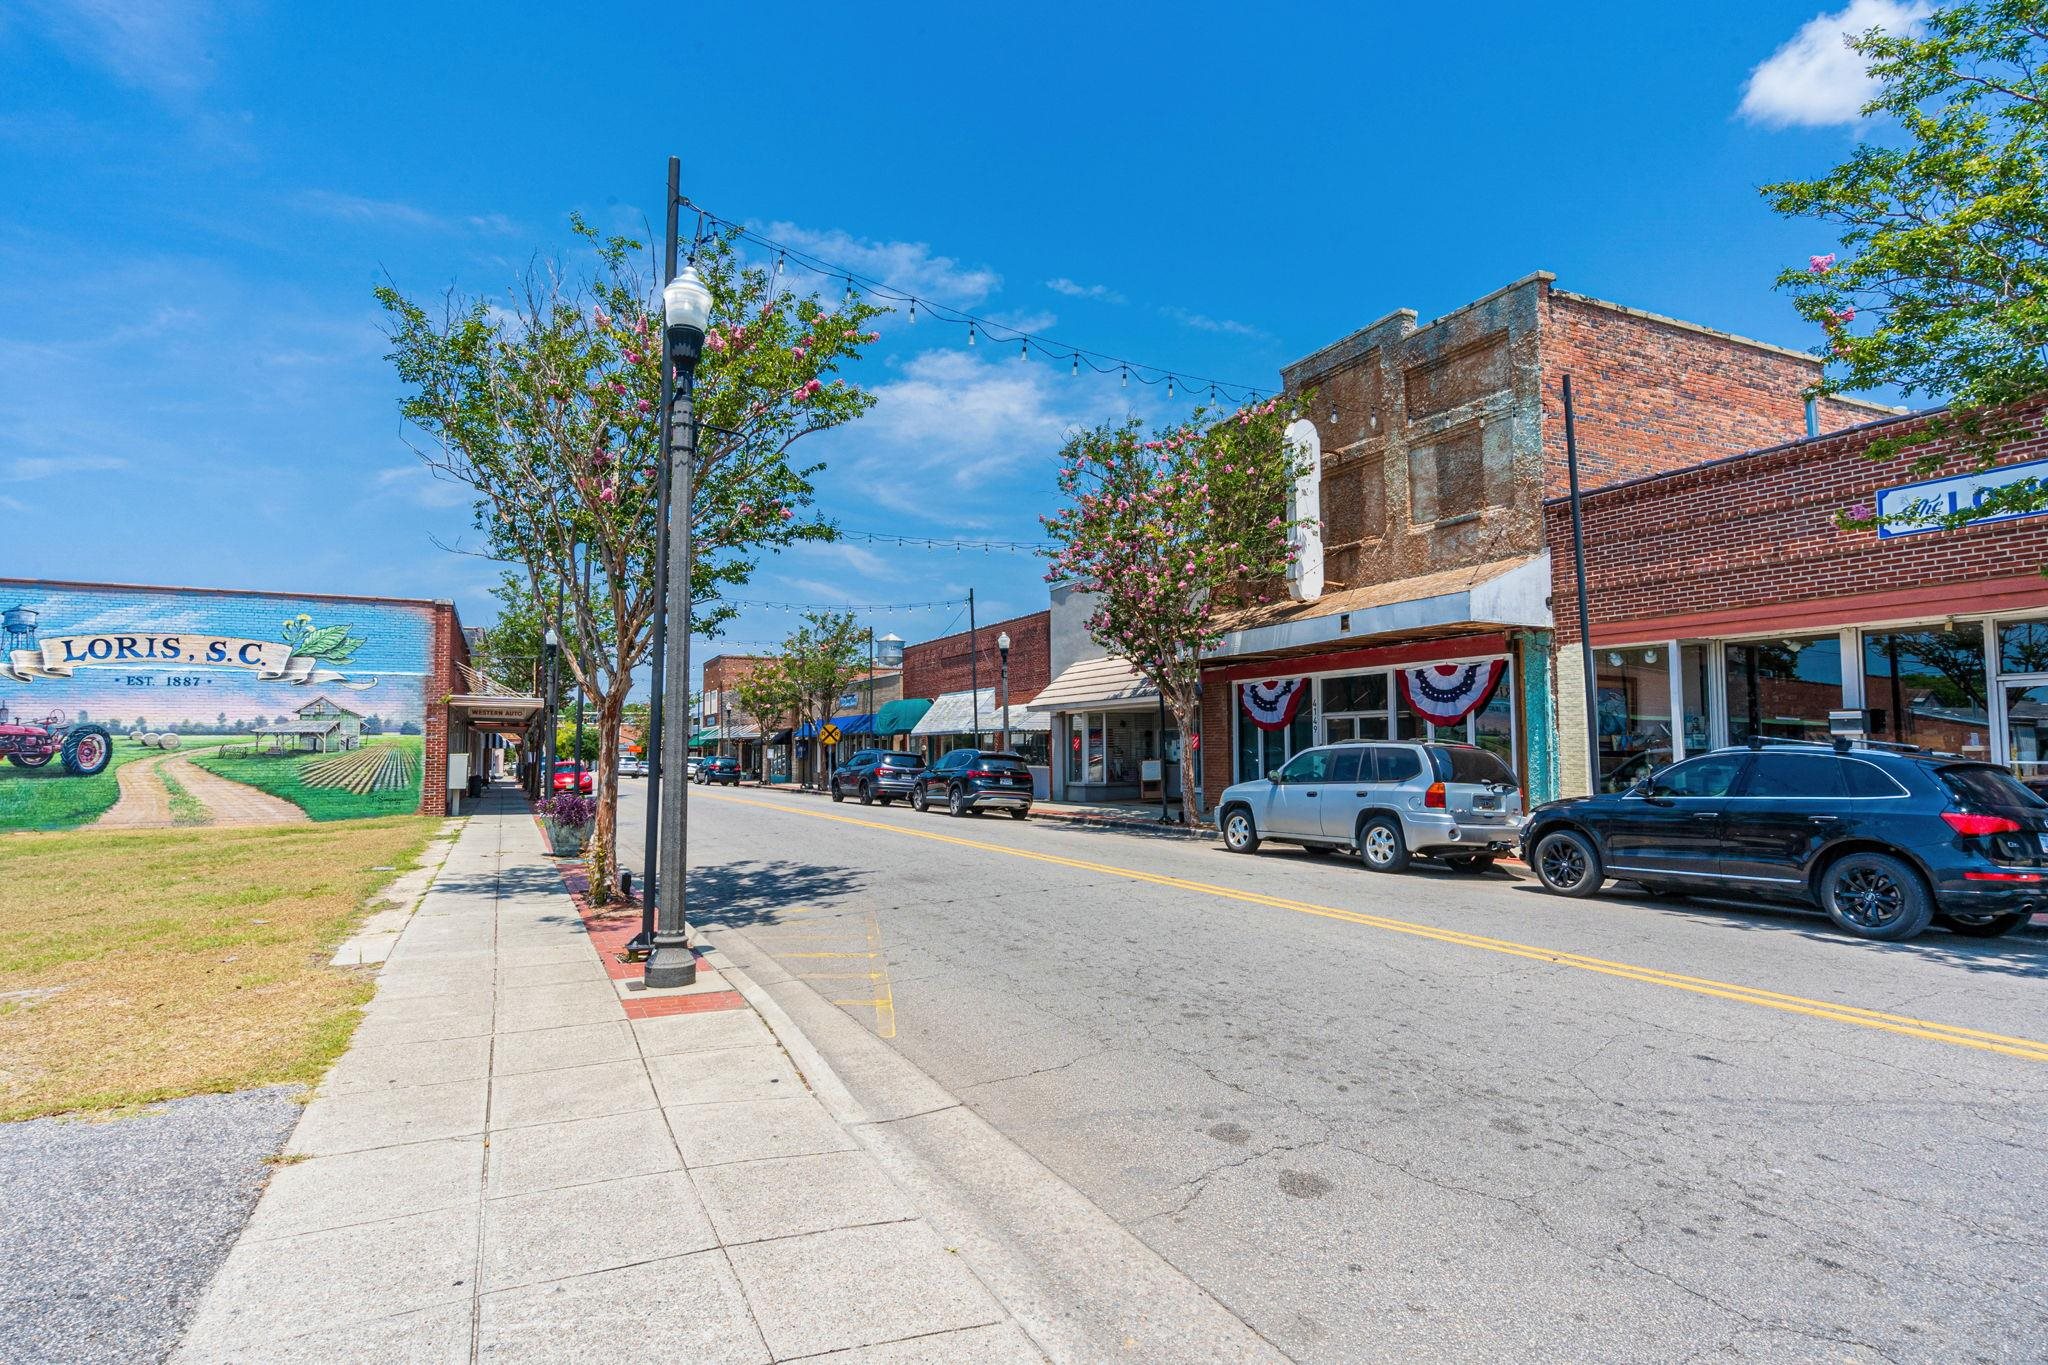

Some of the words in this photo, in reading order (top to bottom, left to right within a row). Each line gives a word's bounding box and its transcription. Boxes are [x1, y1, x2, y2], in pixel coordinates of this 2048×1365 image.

[61, 637, 195, 662] LORIS,
[206, 640, 266, 666] S.C.
[127, 676, 155, 686] EST.
[166, 676, 200, 686] 1887
[504, 709, 523, 717] AUTO
